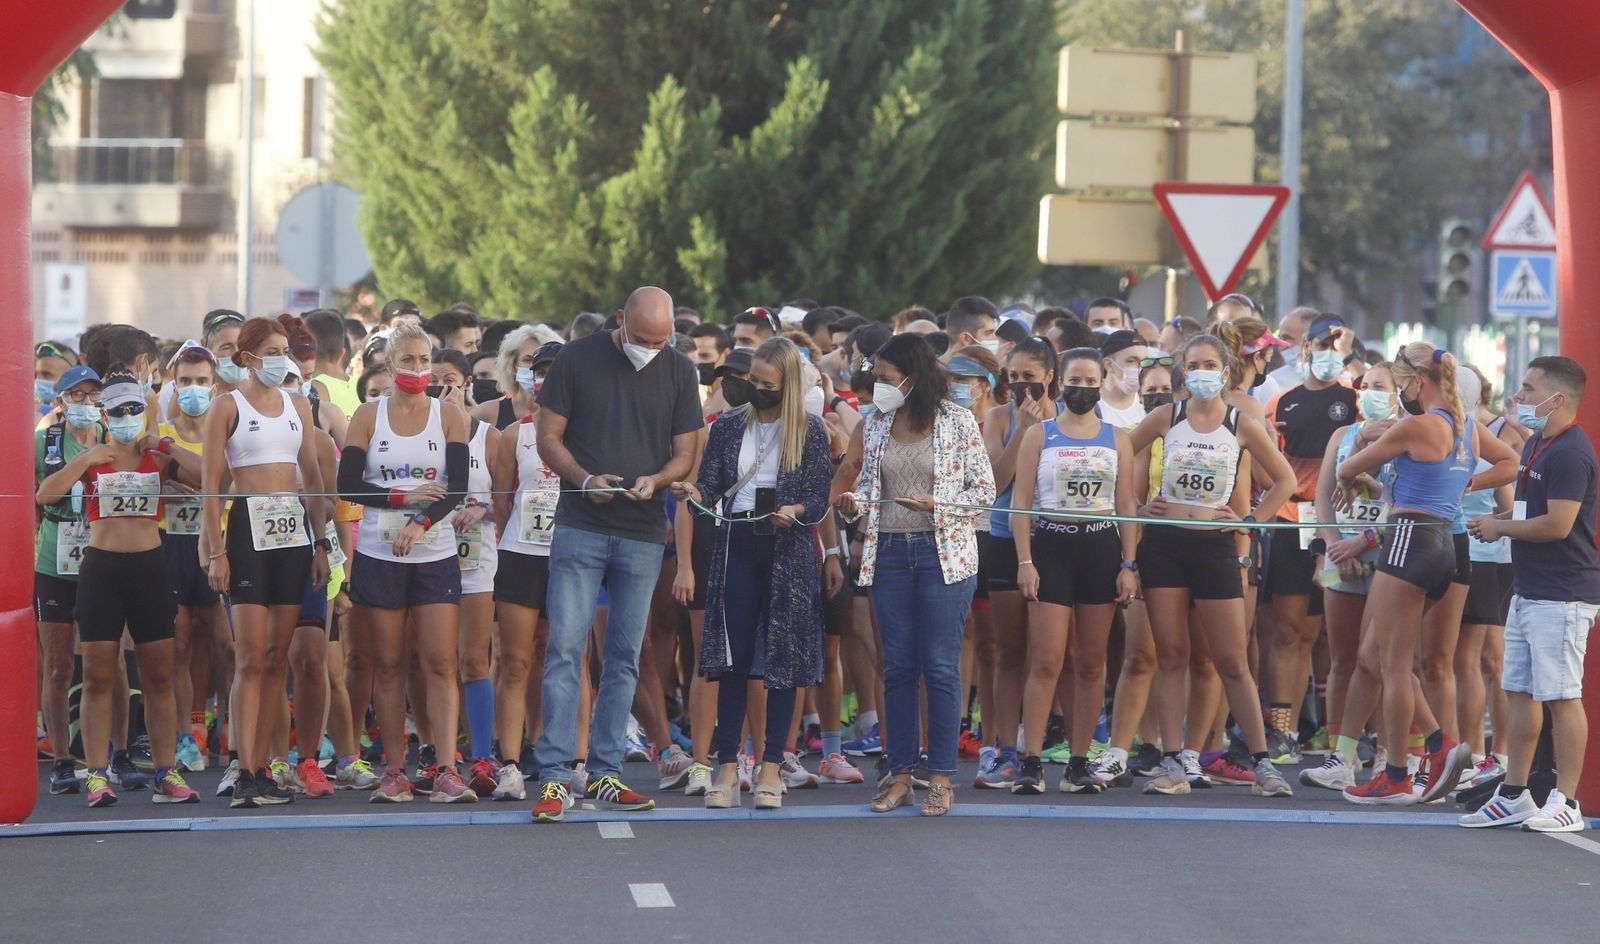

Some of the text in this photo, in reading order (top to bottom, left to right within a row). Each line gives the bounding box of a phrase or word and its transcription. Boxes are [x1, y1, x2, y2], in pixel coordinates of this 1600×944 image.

[1187, 442, 1215, 450] Joma
[380, 464, 438, 481] indea
[1067, 482, 1102, 497] 507
[1176, 473, 1215, 491] 486
[113, 496, 149, 512] 242
[176, 507, 203, 522] 47
[264, 517, 297, 535] 289
[1046, 523, 1079, 533] PRO
[1085, 520, 1113, 533] NIKE
